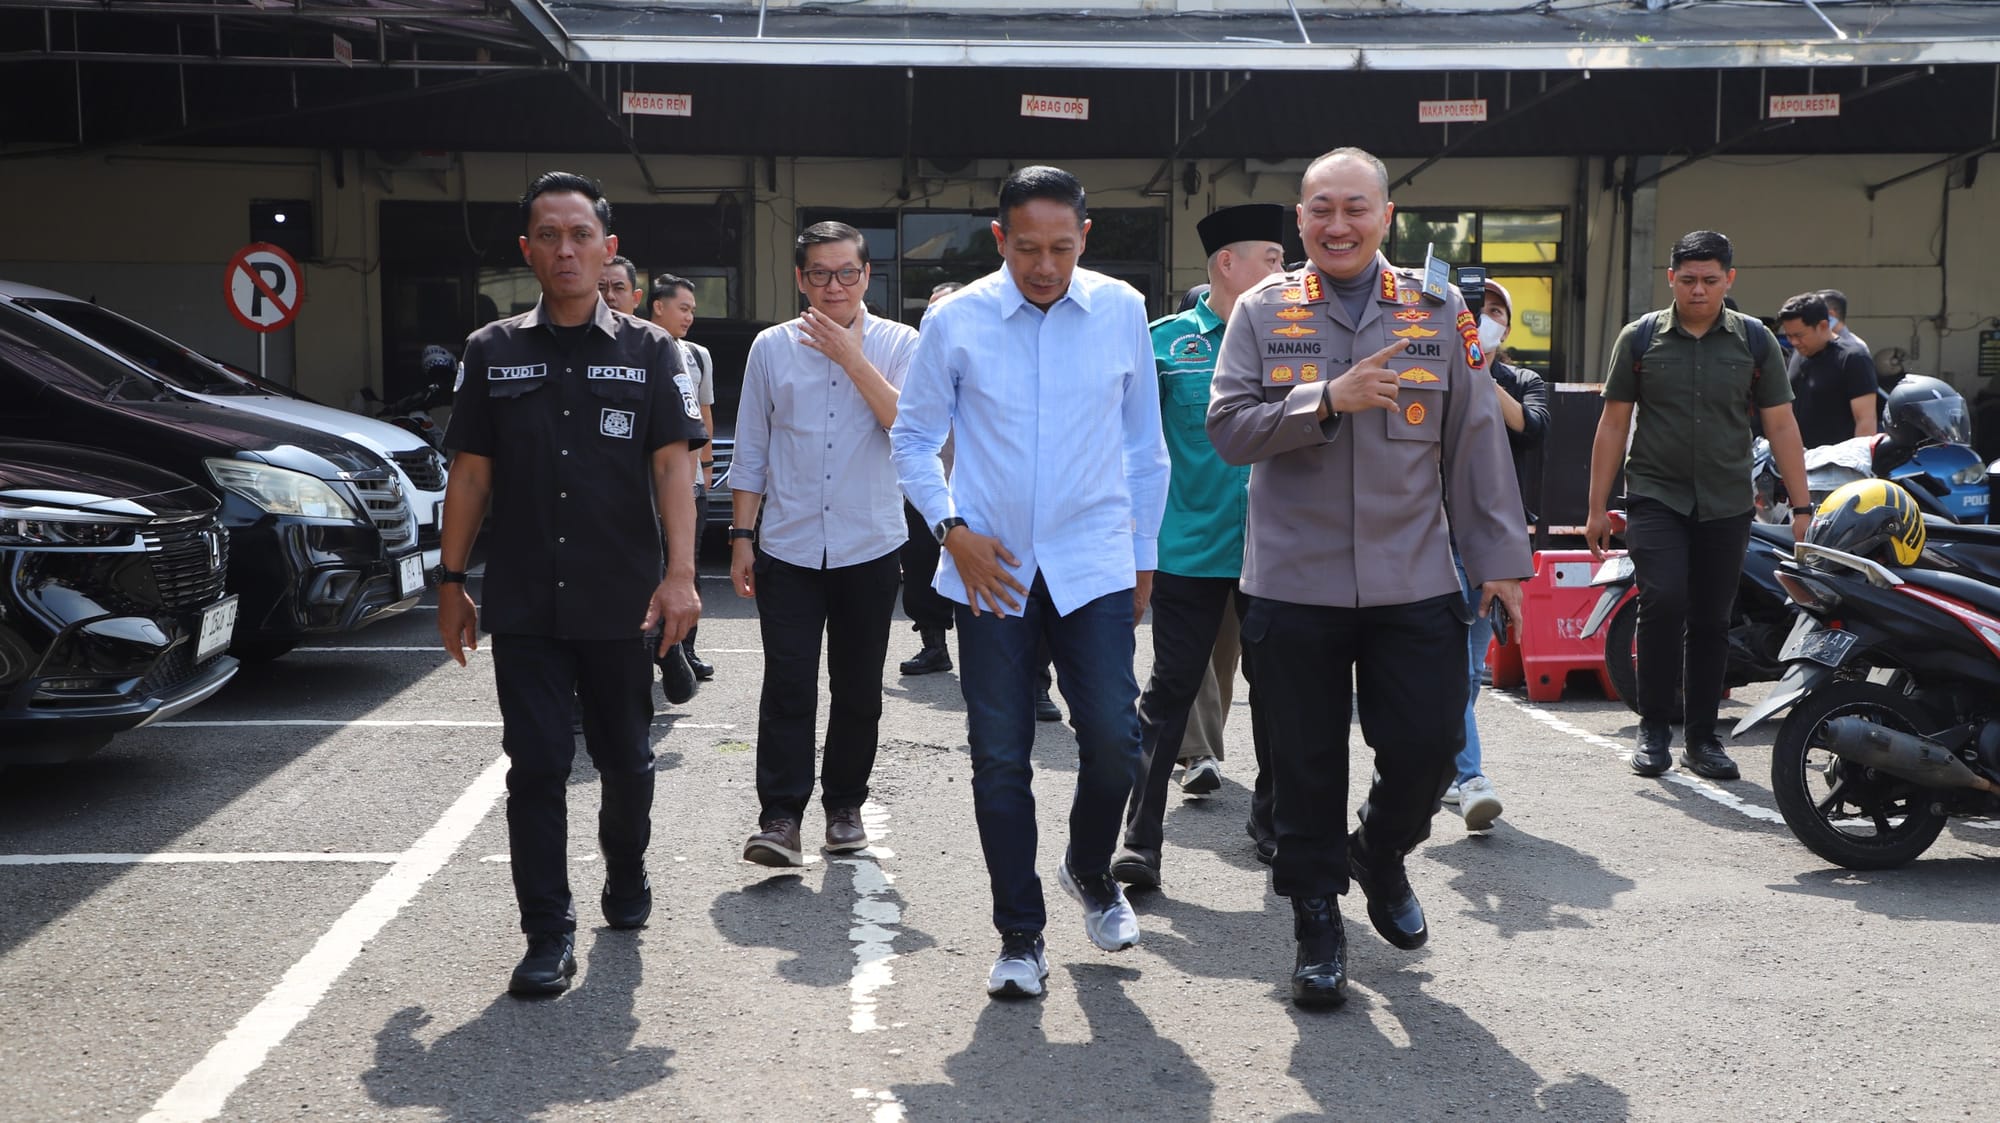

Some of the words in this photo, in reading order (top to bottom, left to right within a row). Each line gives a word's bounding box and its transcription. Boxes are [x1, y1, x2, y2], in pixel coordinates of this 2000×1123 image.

[628, 96, 663, 110] KABAG
[666, 98, 687, 111] REN
[1026, 98, 1061, 113] KABAG
[1063, 101, 1084, 115] OPS
[1444, 103, 1484, 117] POLRESTA
[1772, 98, 1837, 112] KAPOLRESTA
[250, 262, 286, 317] P
[1267, 342, 1321, 355] NANANG
[1404, 343, 1441, 357] OLRI
[500, 367, 535, 378] YUDI
[592, 368, 642, 381] POLRI
